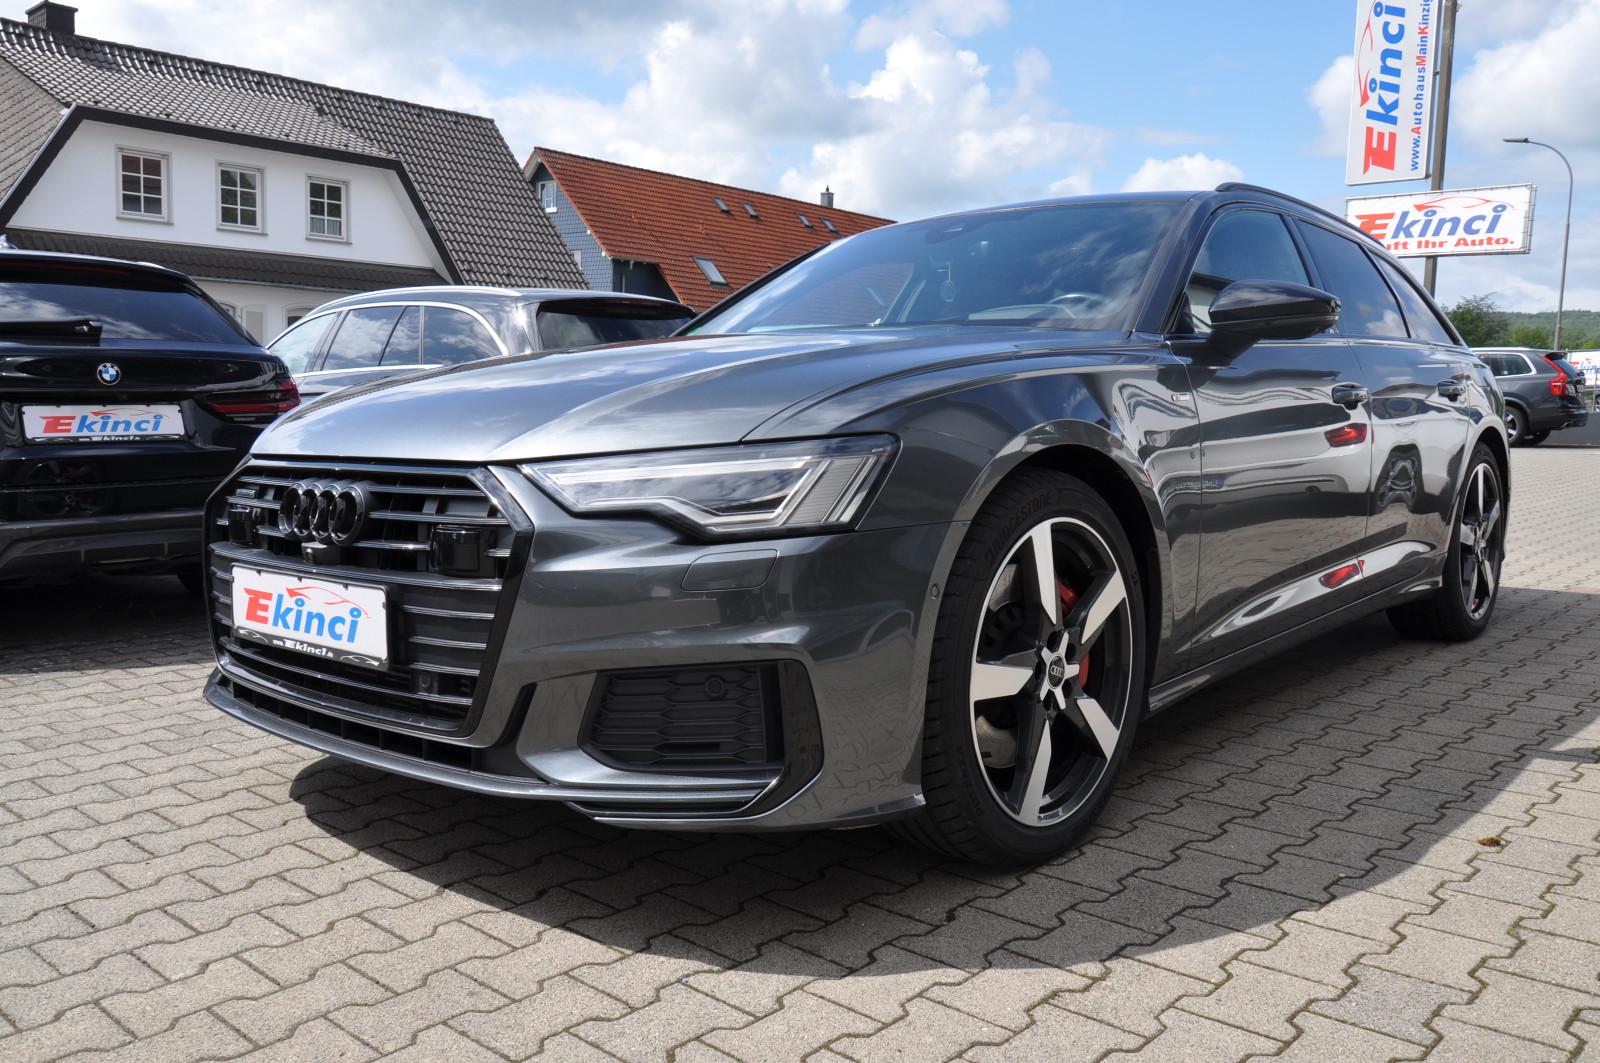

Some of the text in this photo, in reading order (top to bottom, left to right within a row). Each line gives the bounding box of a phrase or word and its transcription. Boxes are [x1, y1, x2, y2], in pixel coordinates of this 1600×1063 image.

[1363, 1, 1406, 175] Ekinci
[1355, 204, 1508, 240] Ekinci
[1417, 239, 1448, 248] Ihr
[1454, 236, 1514, 247] Auto.
[39, 414, 163, 433] Ekinci
[244, 588, 362, 643] Ekinci
